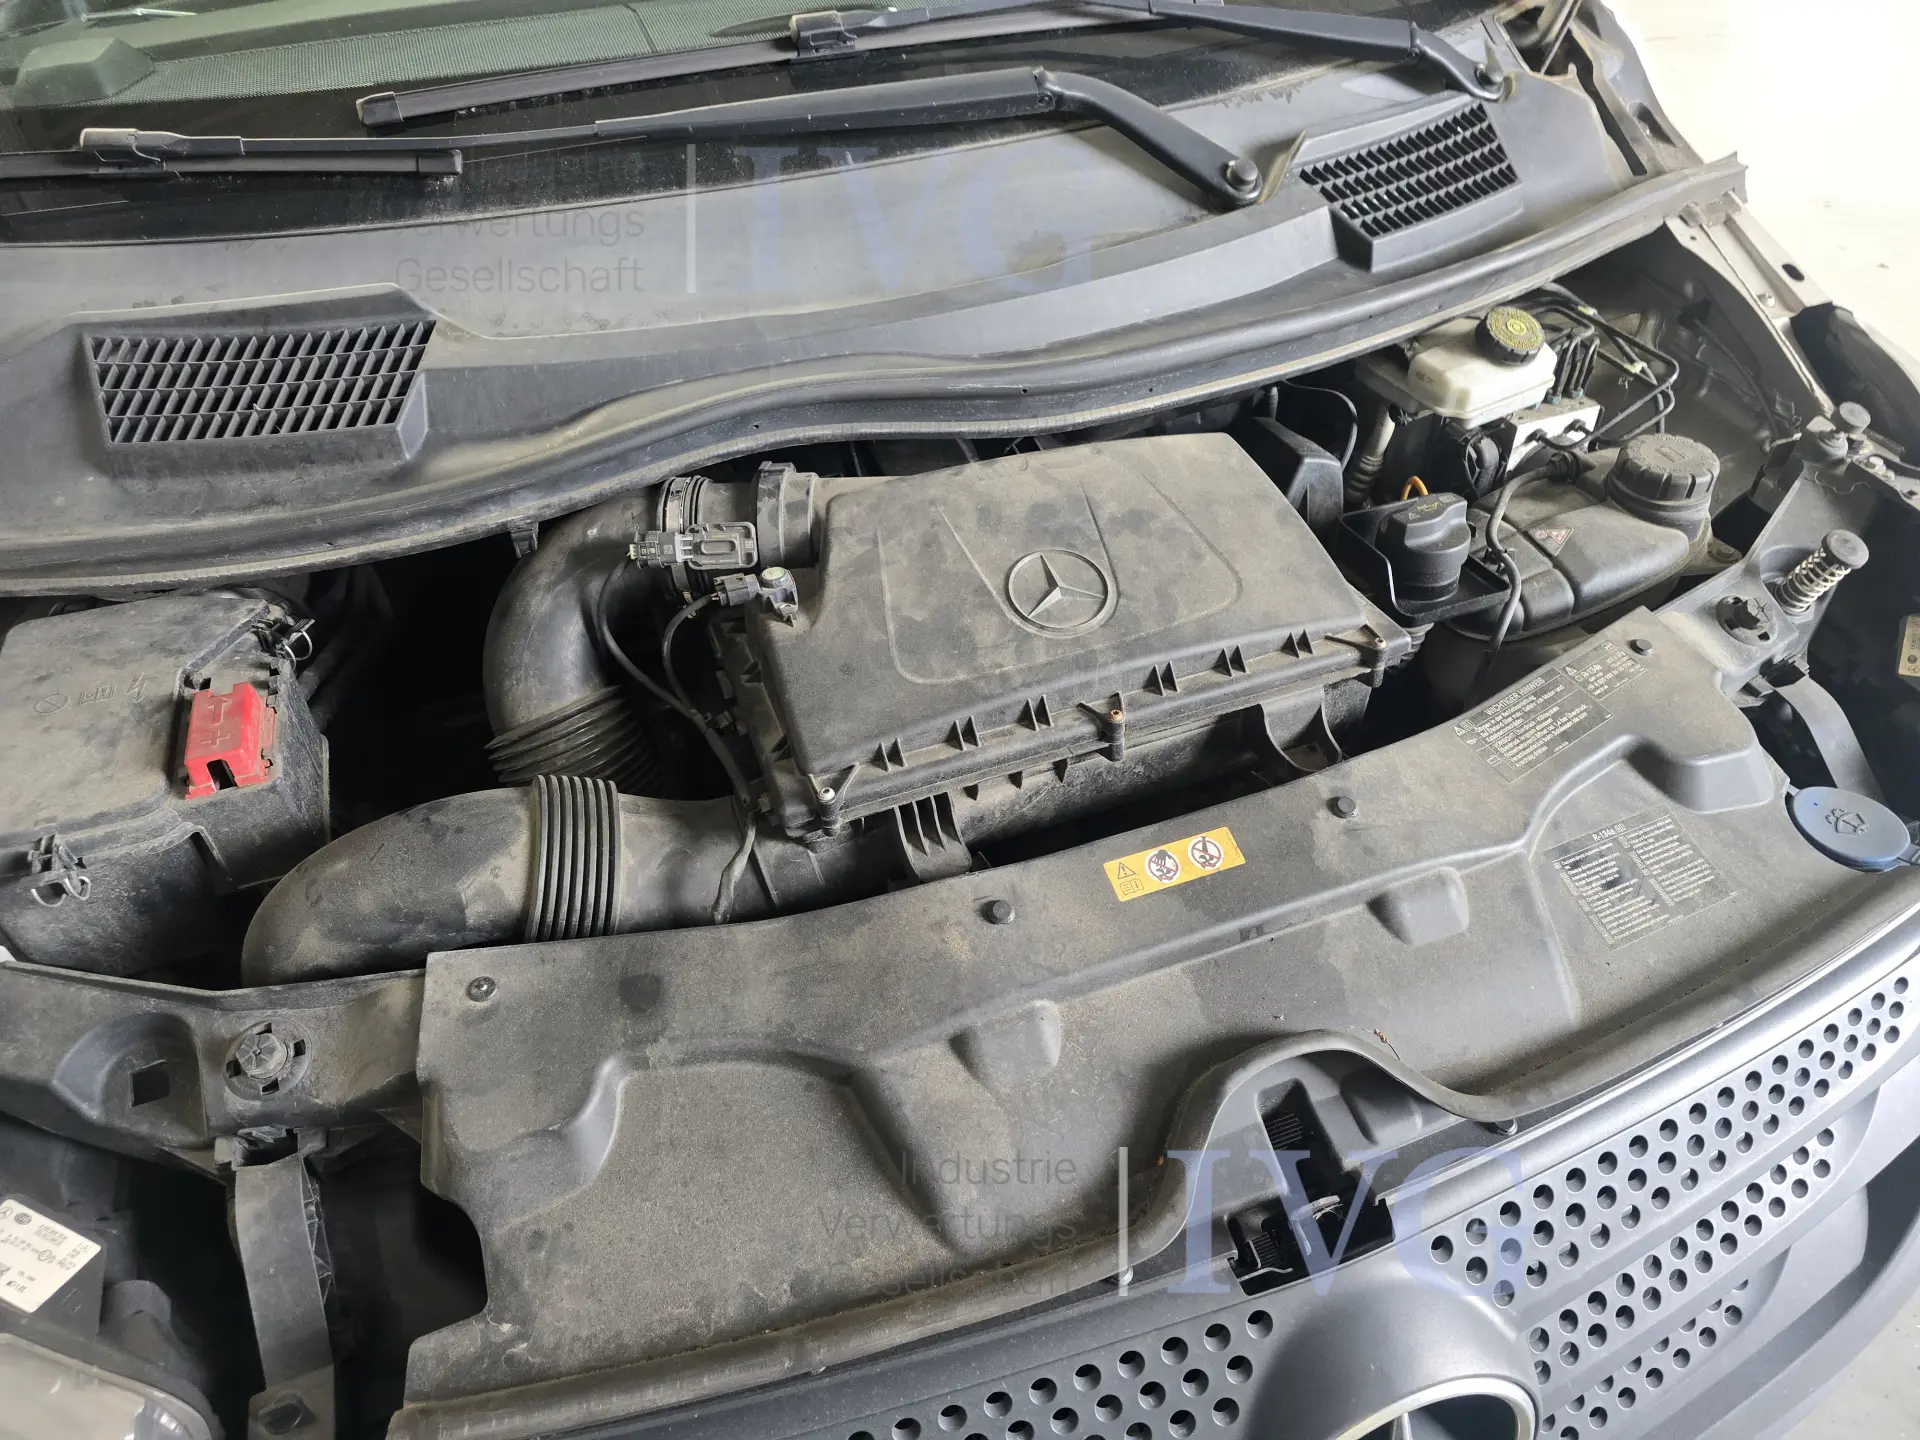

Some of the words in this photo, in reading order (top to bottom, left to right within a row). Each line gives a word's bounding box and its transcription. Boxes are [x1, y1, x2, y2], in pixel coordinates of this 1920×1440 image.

[1483, 691, 1521, 715] WICHTIGER
[1516, 676, 1546, 695] HINWEIS
[1591, 827, 1616, 841] R-134a
